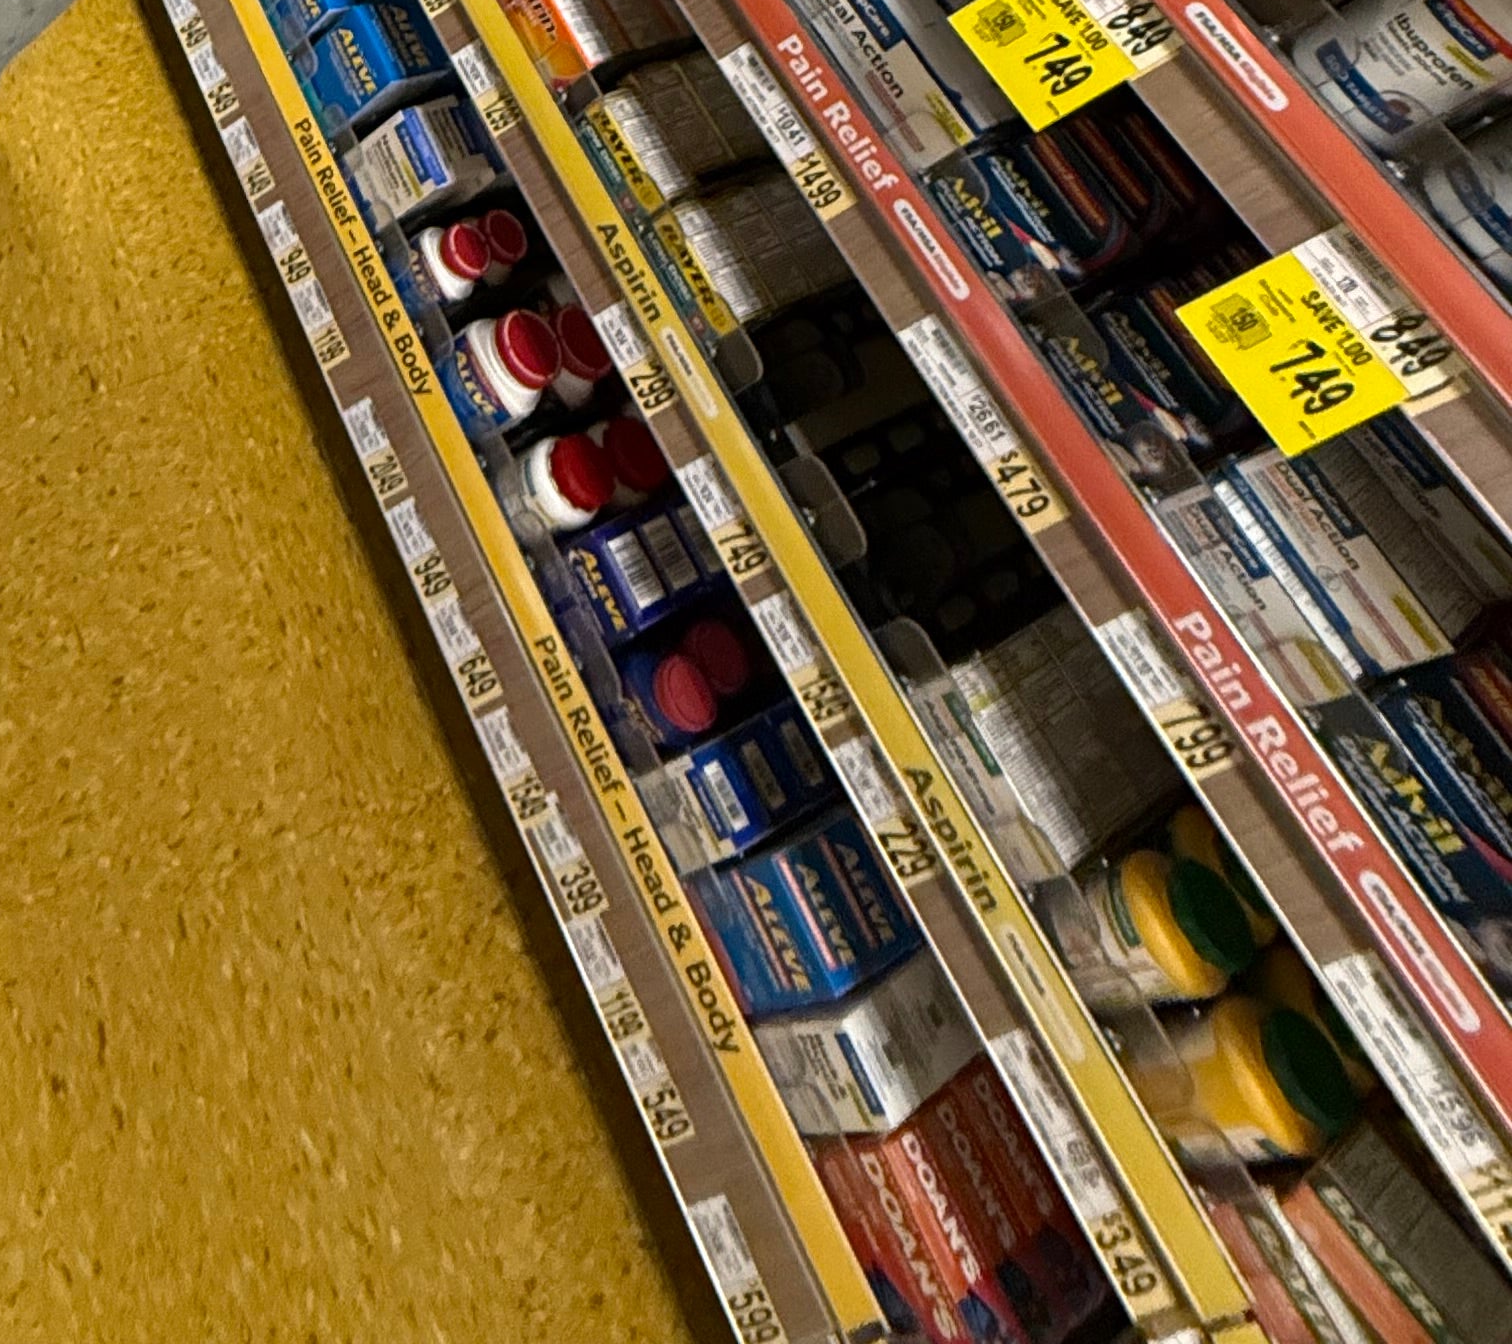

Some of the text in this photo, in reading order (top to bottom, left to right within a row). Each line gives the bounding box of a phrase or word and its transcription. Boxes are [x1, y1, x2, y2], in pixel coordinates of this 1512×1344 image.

[337, 27, 378, 97] ALEVE
[852, 23, 904, 100] Action
[1194, 8, 1242, 62] FSA/HSA
[1391, 11, 1476, 92] Ibuprofen
[777, 33, 829, 103] Pain
[823, 101, 899, 191] Relief
[293, 117, 433, 399] Pain Relief Head & Body
[952, 177, 1004, 241] Advil
[597, 222, 663, 324] Aspirin
[660, 215, 717, 307] BAYER
[1300, 289, 1342, 335] SAVE
[1060, 336, 1123, 405] Advil
[1276, 462, 1360, 571] Dual Action
[1219, 547, 1267, 612] Action
[1174, 610, 1366, 854] Pain Relief
[535, 634, 740, 1054] Pain Relief Head & Body
[903, 766, 998, 914] Aspirin
[1368, 739, 1467, 856] Advil
[743, 869, 814, 995] ALEVE
[901, 1131, 983, 1284] DOAN'S
